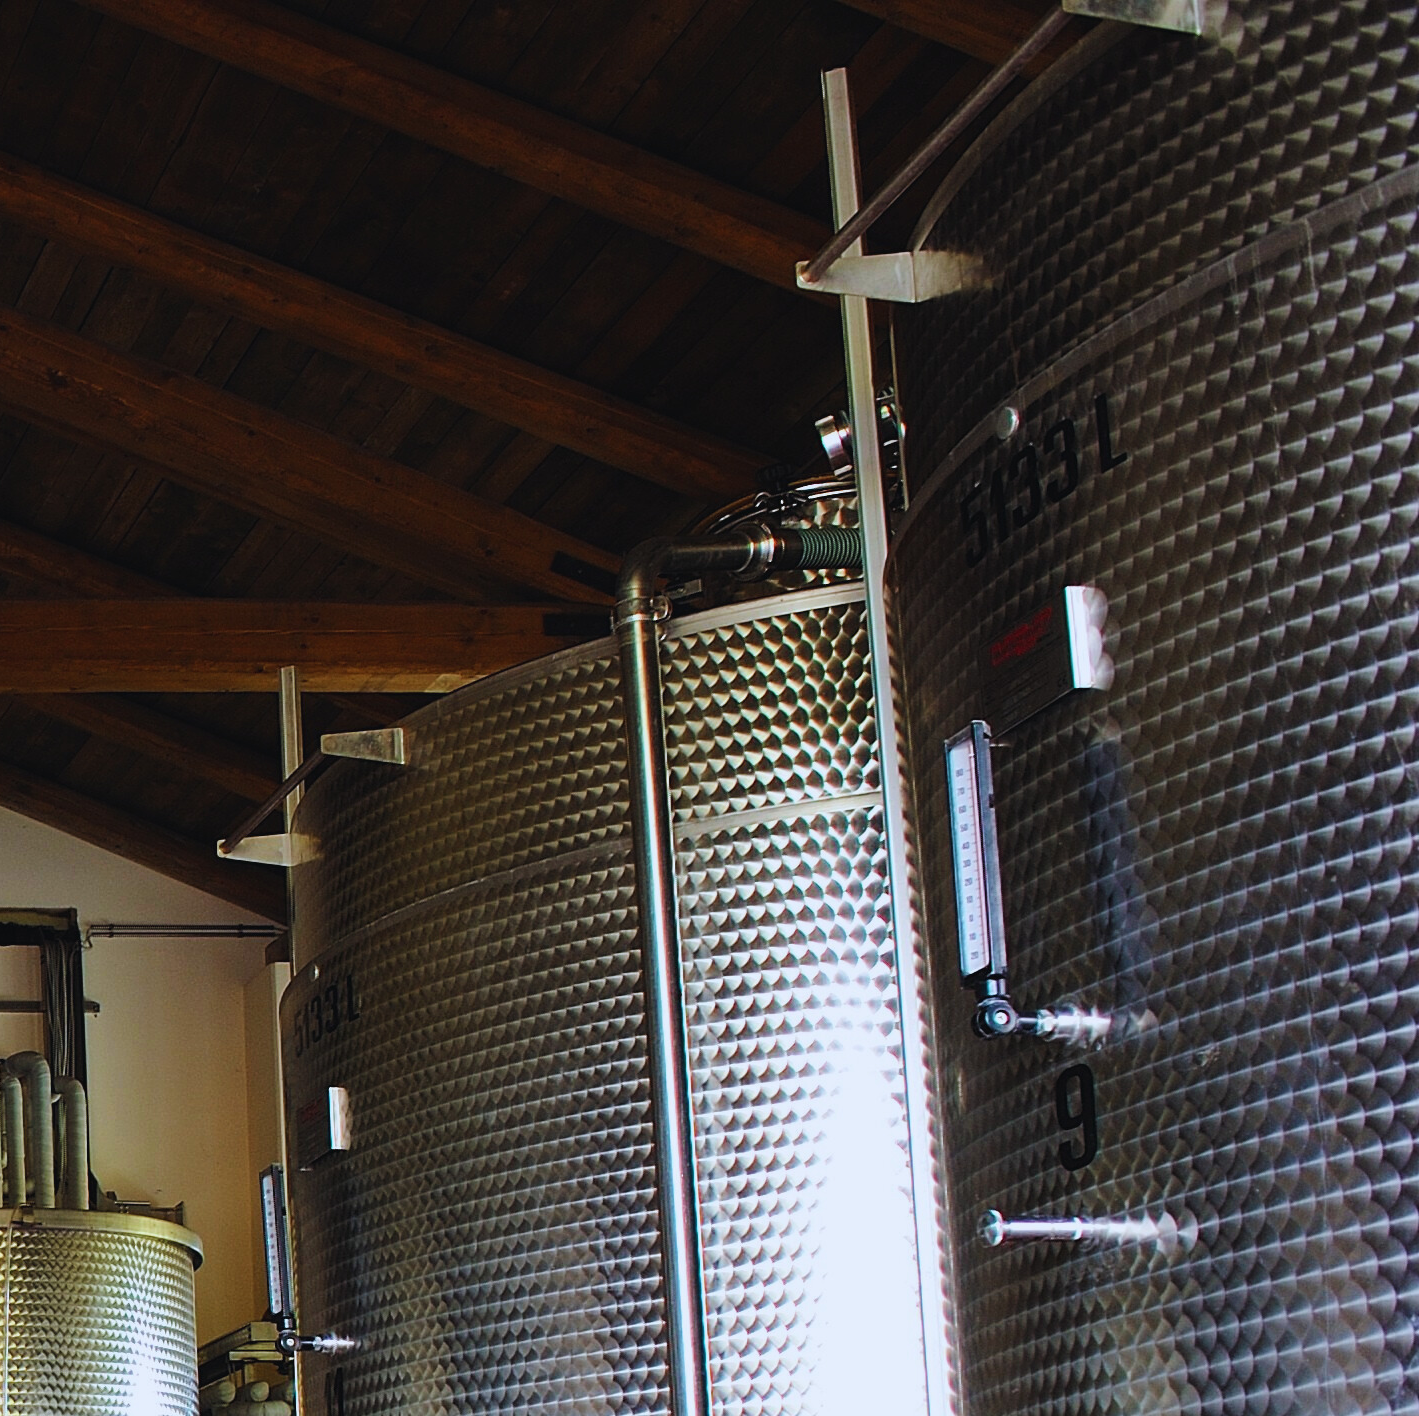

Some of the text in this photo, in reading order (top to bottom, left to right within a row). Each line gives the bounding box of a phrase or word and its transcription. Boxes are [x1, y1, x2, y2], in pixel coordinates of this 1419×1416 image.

[960, 392, 1128, 569] 5133 L
[293, 974, 360, 1058] 5133 L
[1056, 1063, 1098, 1172] 9
